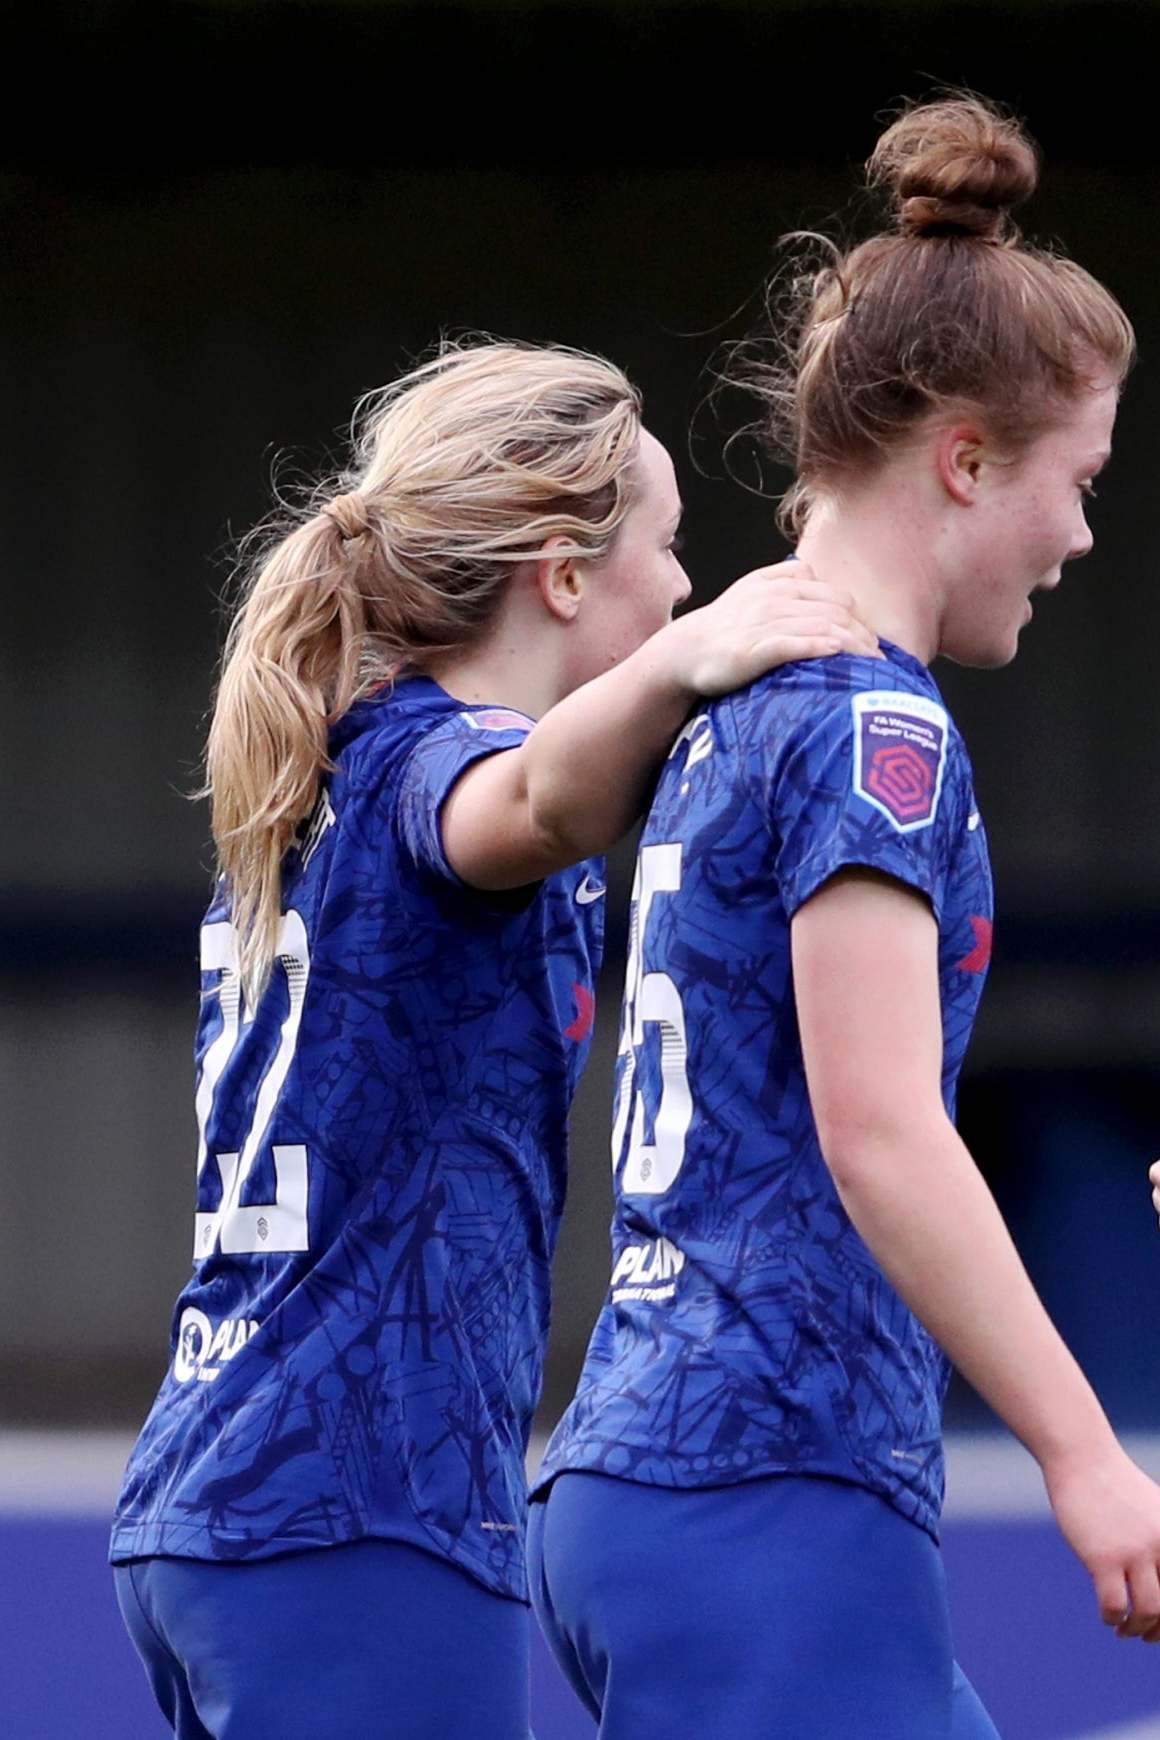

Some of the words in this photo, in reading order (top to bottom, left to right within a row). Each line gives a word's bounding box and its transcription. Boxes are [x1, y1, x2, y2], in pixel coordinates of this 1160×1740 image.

[873, 716, 889, 726] FA
[868, 724, 902, 737] Super
[903, 730, 938, 751] League
[610, 1236, 685, 1286] PLAN
